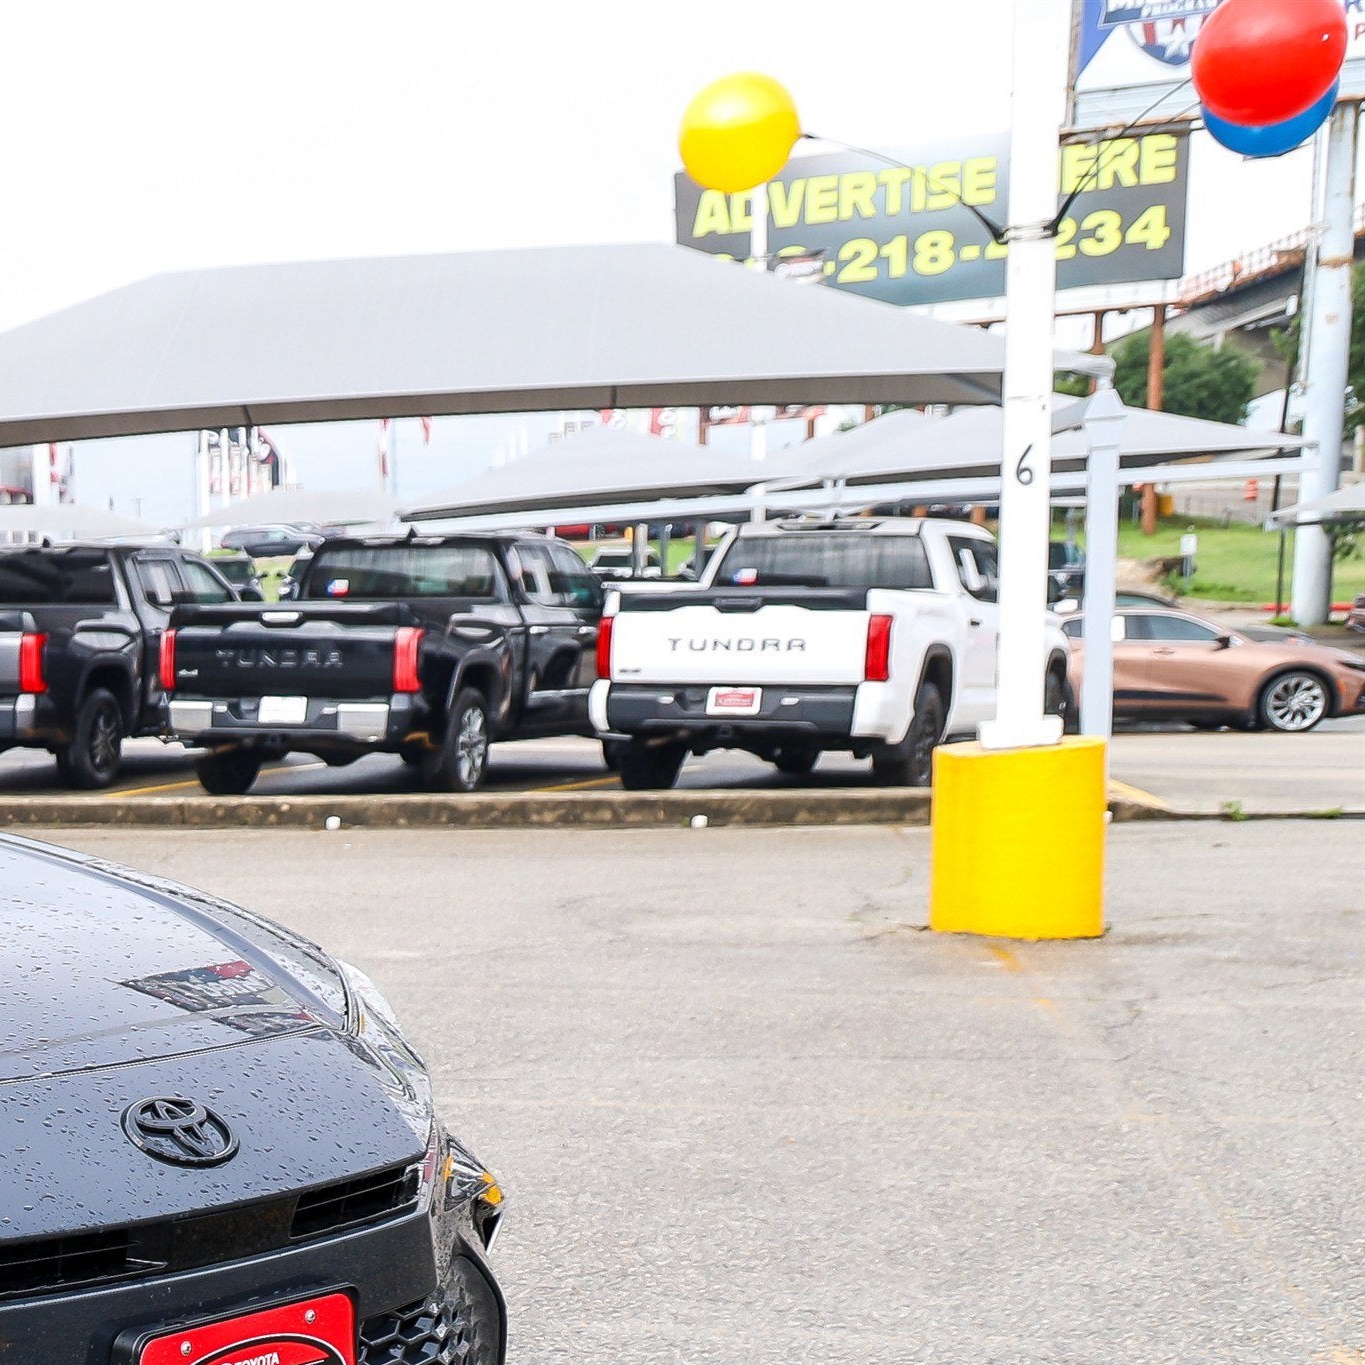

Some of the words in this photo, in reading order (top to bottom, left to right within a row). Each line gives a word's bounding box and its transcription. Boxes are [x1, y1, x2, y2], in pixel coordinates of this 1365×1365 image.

[691, 156, 998, 238] ADVERTISE
[1059, 133, 1178, 195] ERE
[1015, 443, 1035, 487] 6
[214, 648, 344, 669] TUNDRA
[667, 637, 807, 653] TUNDRA
